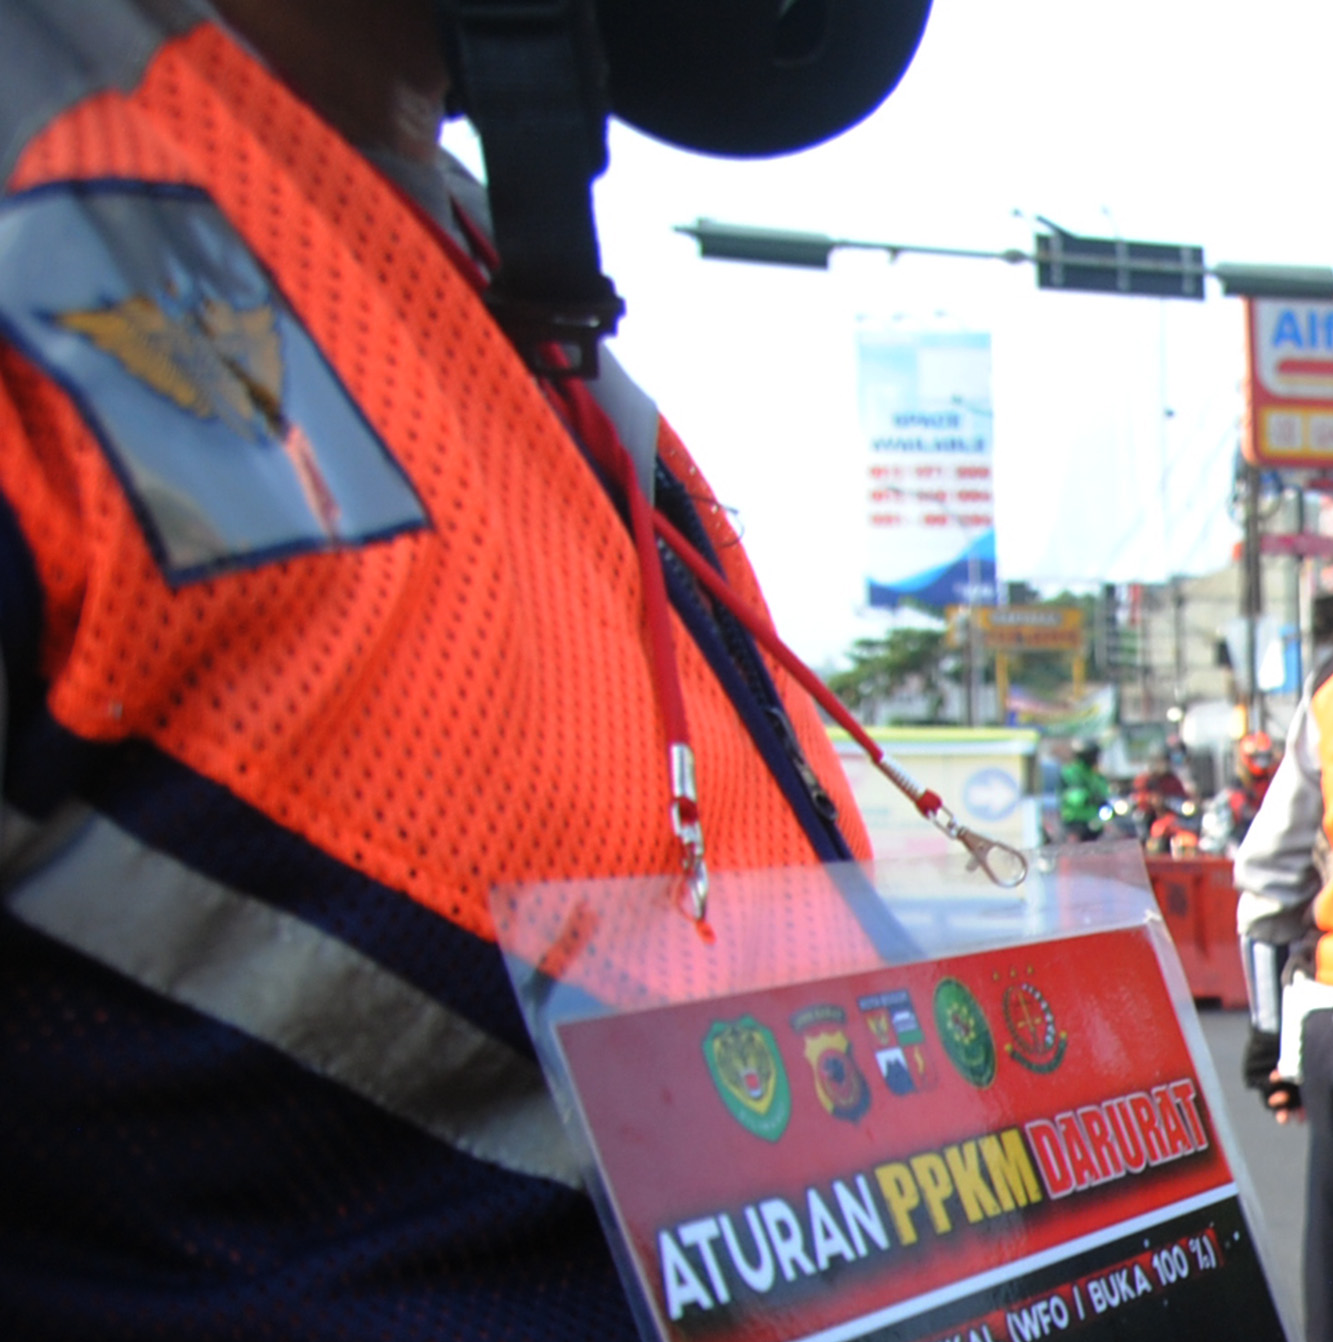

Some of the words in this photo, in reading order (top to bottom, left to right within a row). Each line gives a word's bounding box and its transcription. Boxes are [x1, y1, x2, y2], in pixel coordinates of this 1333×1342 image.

[639, 1172, 891, 1322] ATURAN
[872, 1127, 1044, 1247] PPKM
[1023, 1076, 1215, 1203] DARURAT
[1084, 1258, 1154, 1314] BUKA
[1149, 1242, 1192, 1287] 100
[1187, 1232, 1218, 1271] %)
